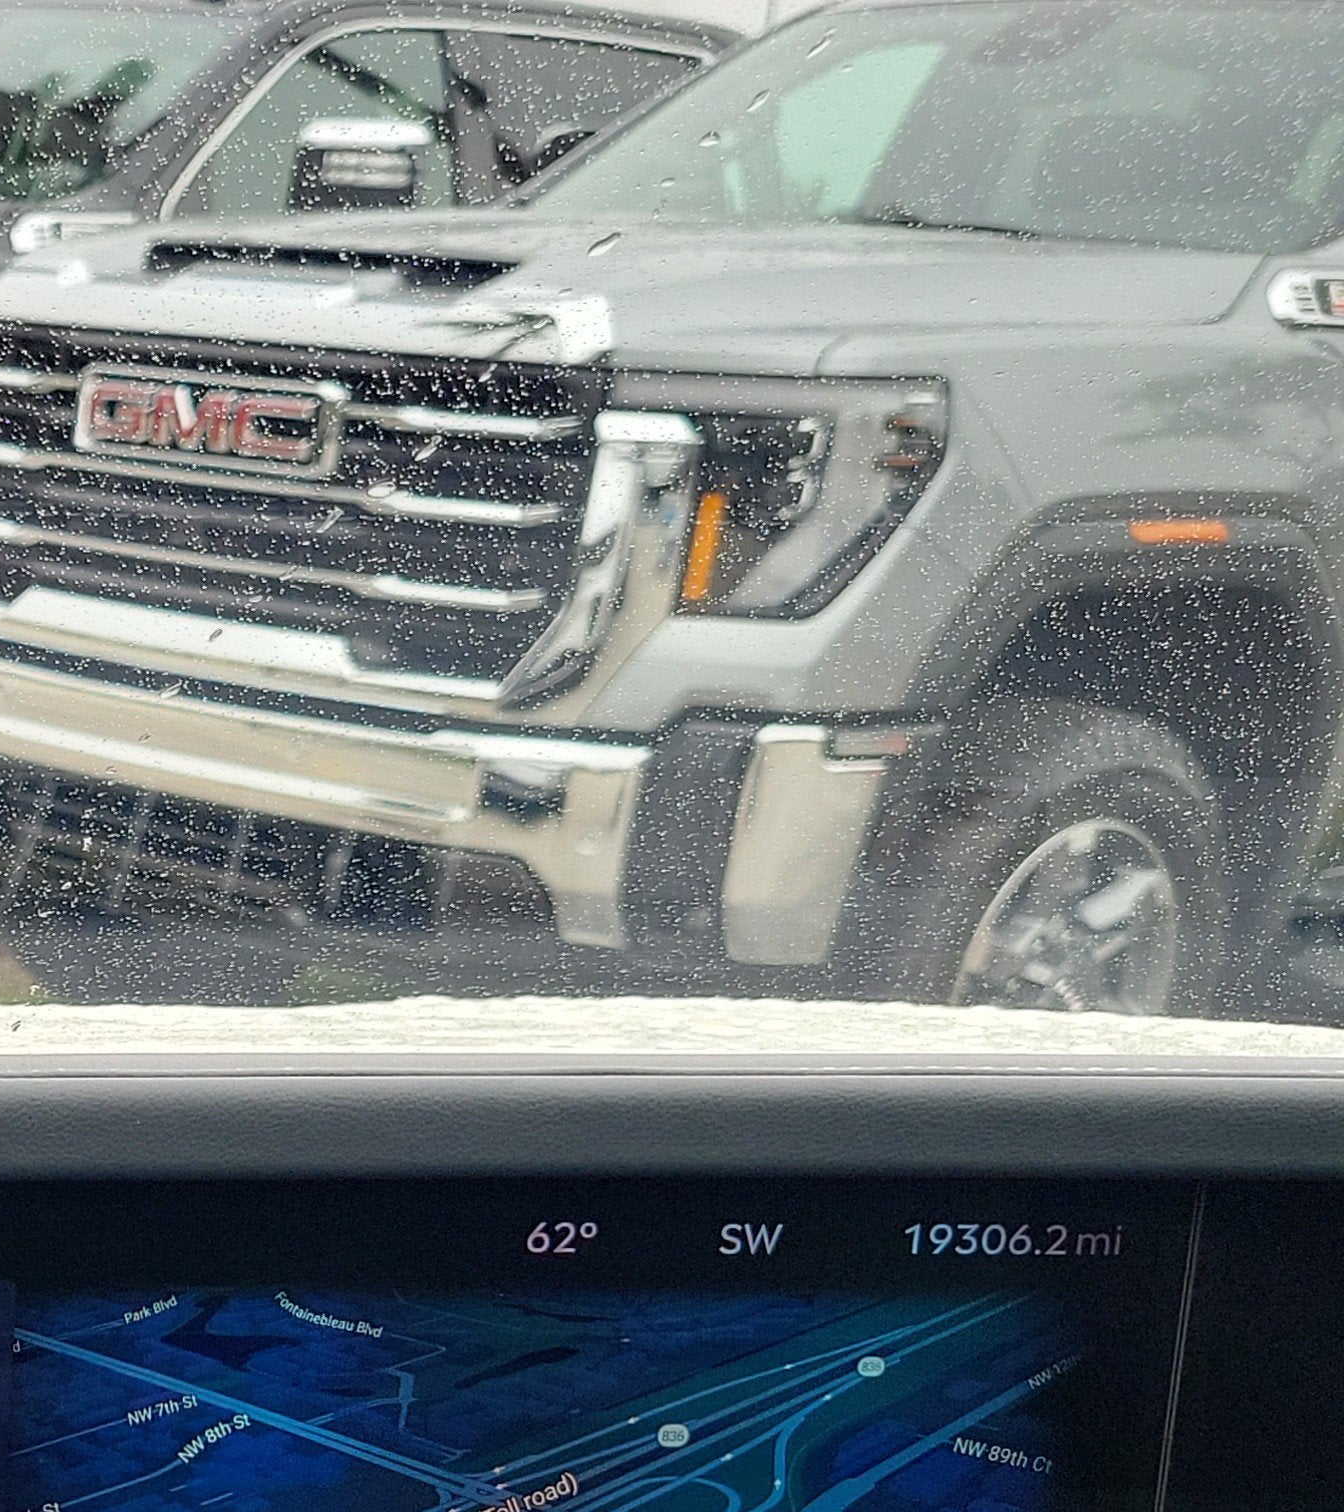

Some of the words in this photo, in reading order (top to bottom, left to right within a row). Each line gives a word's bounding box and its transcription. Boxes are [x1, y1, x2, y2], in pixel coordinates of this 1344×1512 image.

[89, 381, 318, 462] GMC
[719, 1223, 784, 1255] SW
[904, 1223, 1068, 1256] 19306.2
[1075, 1225, 1123, 1255] mi
[123, 1306, 152, 1325] Park
[153, 1295, 179, 1314] Blvd
[274, 1291, 355, 1332] Fontainebleau
[356, 1321, 384, 1338] Blvd
[127, 1406, 152, 1427] NW
[154, 1399, 180, 1418] 7th
[181, 1394, 198, 1411] St
[177, 1436, 205, 1464] NW
[204, 1421, 232, 1444] 8th
[232, 1413, 251, 1430] St
[660, 1429, 686, 1443] 836
[952, 1436, 985, 1459] NW
[988, 1445, 1028, 1469] 89th
[1032, 1456, 1054, 1474] Ct
[523, 1472, 580, 1511] road)
